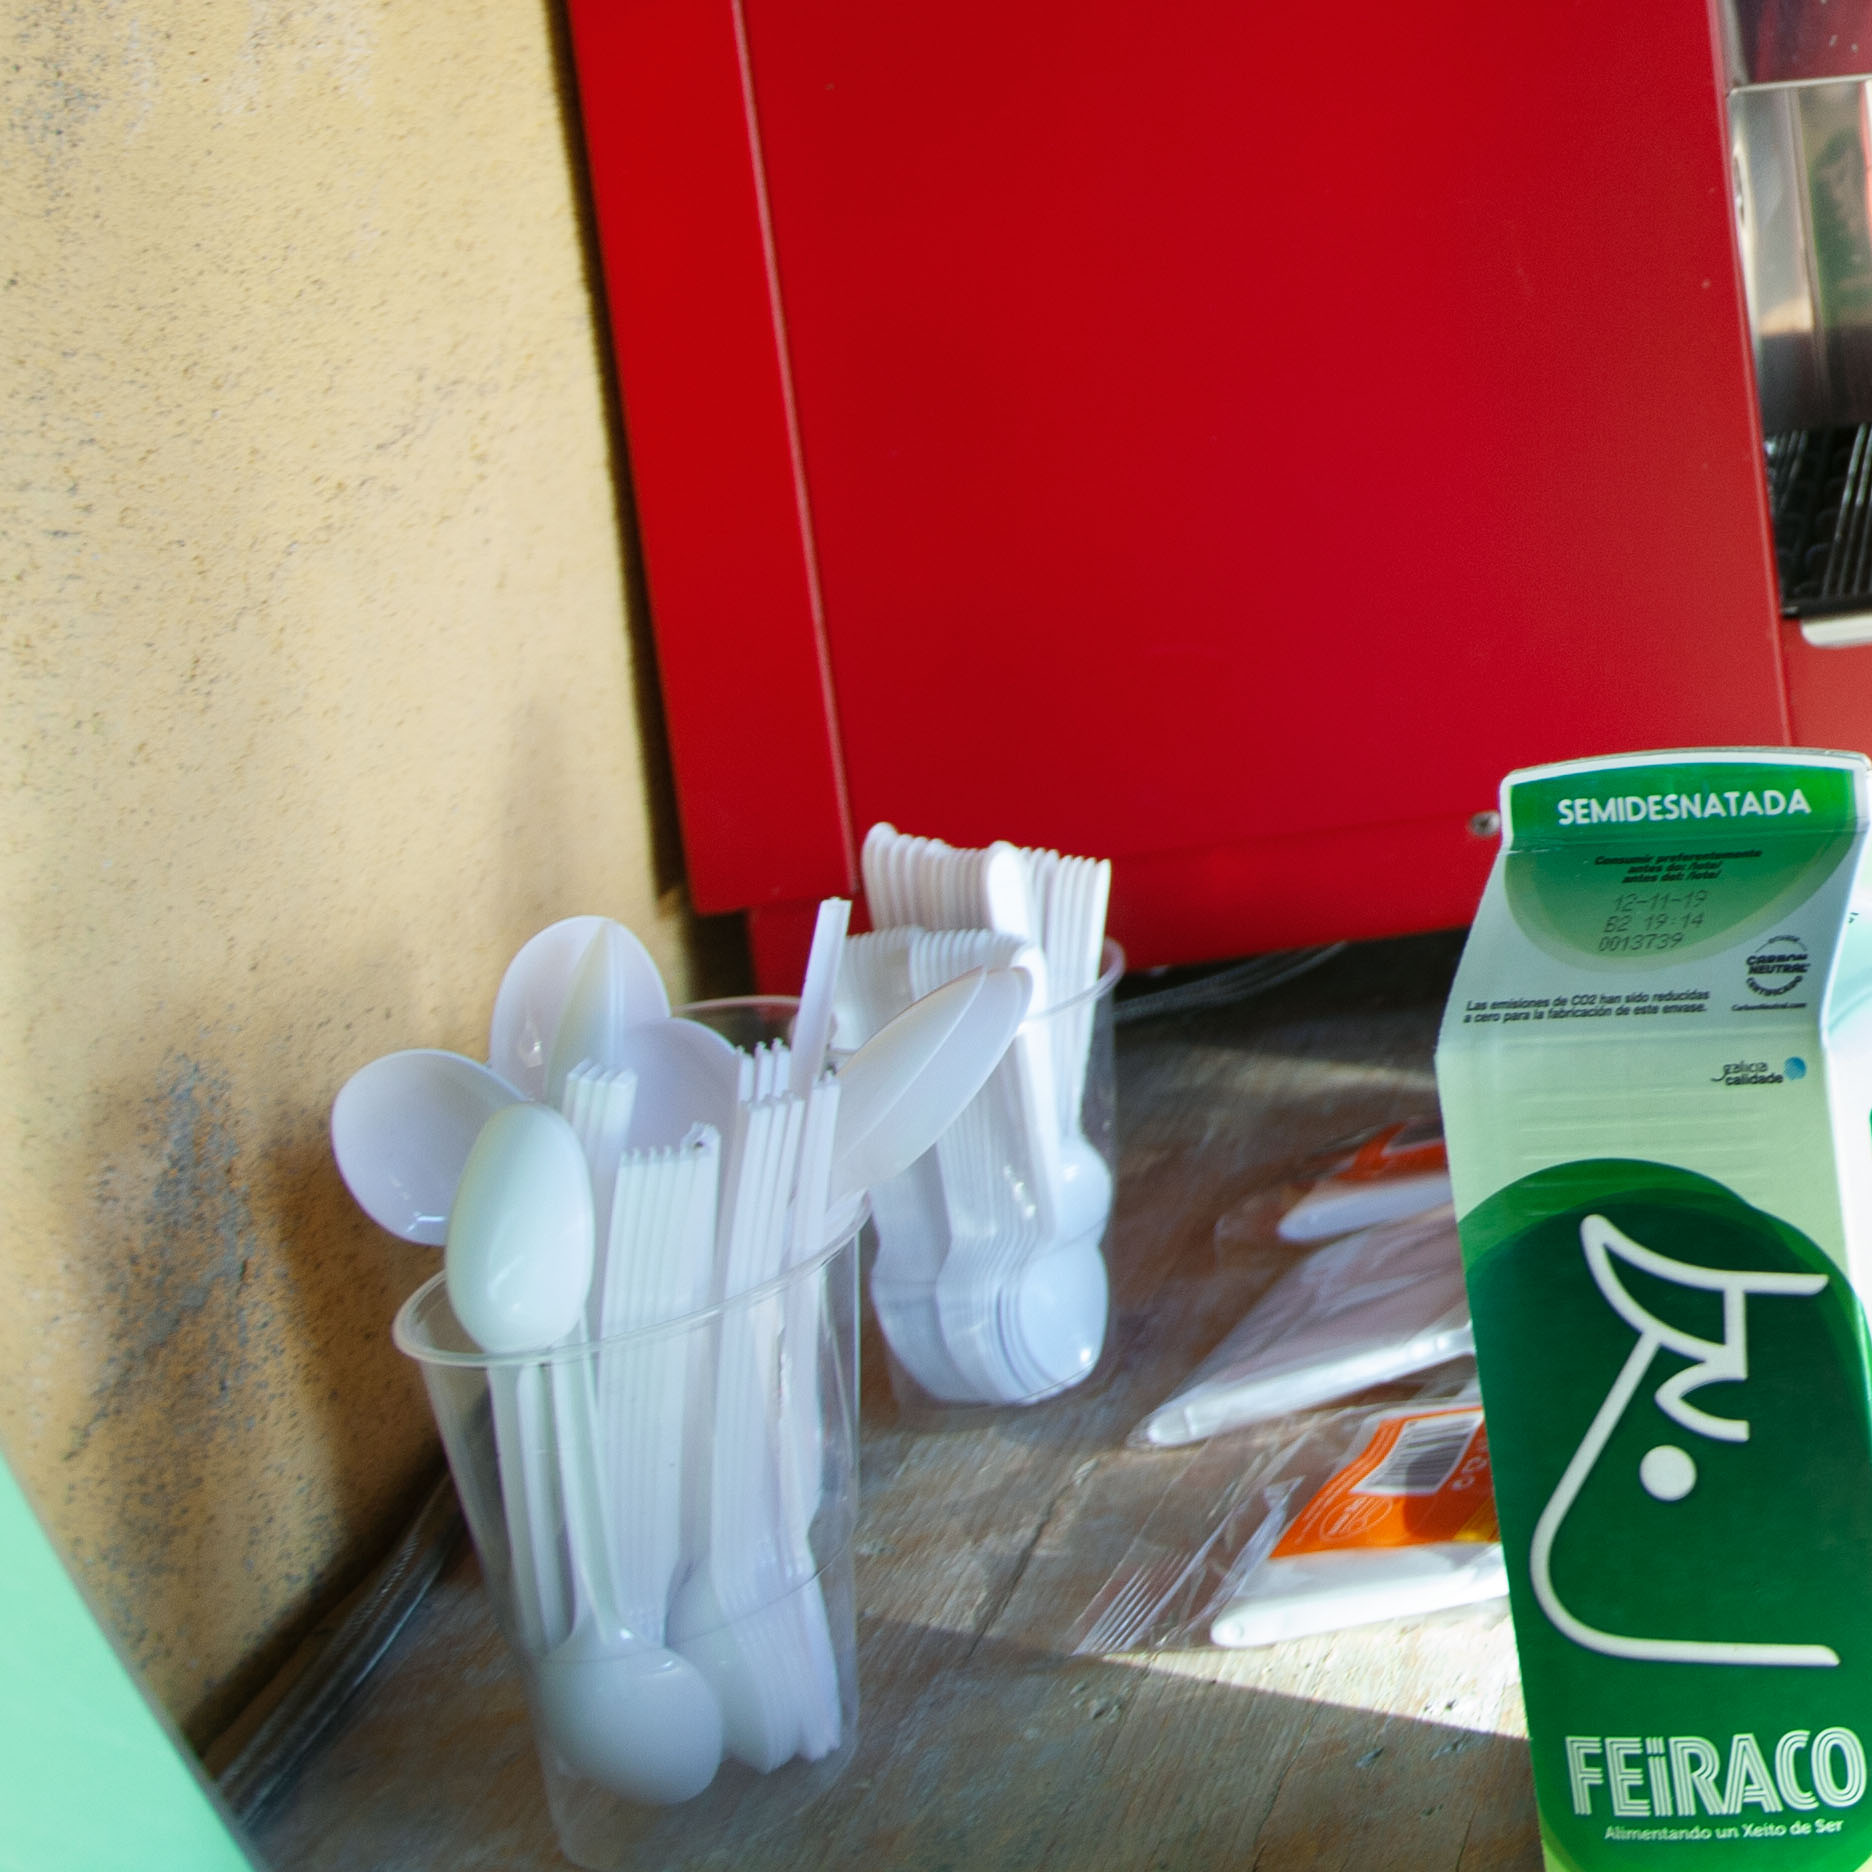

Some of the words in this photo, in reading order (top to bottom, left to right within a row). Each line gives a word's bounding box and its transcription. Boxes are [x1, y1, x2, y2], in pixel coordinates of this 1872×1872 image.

[1557, 789, 1812, 825] SEMIDESNATADA
[1594, 854, 1653, 866] Consumir
[1655, 849, 1763, 864] preferentemente
[1621, 873, 1659, 884] antes
[1627, 864, 1664, 874] antes
[1614, 890, 1709, 912] 12-11-19
[1645, 912, 1706, 931] 19:14
[1598, 932, 1686, 952] 0013739
[1746, 953, 1809, 966] CARBON
[1465, 1000, 1488, 1011] Las
[1490, 997, 1550, 1010] emisiones
[1553, 995, 1568, 1008] de
[1571, 994, 1596, 1006] CO2
[1599, 993, 1622, 1005] han
[1624, 992, 1650, 1004] sido
[1652, 988, 1711, 1002] reducidas
[1473, 1012, 1500, 1023] cero
[1502, 1011, 1531, 1024] para
[1533, 1008, 1545, 1020] la
[1547, 1005, 1612, 1019] fabricación
[1615, 1004, 1631, 1016] de
[1633, 1004, 1659, 1016] este
[1717, 1060, 1768, 1078] galicia
[1725, 1072, 1785, 1086] calidade
[1604, 1825, 1712, 1841] Alimentando
[1715, 1826, 1739, 1839] un
[1742, 1822, 1787, 1838] Xeito
[1789, 1821, 1812, 1836] de
[1814, 1818, 1845, 1834] Ser
